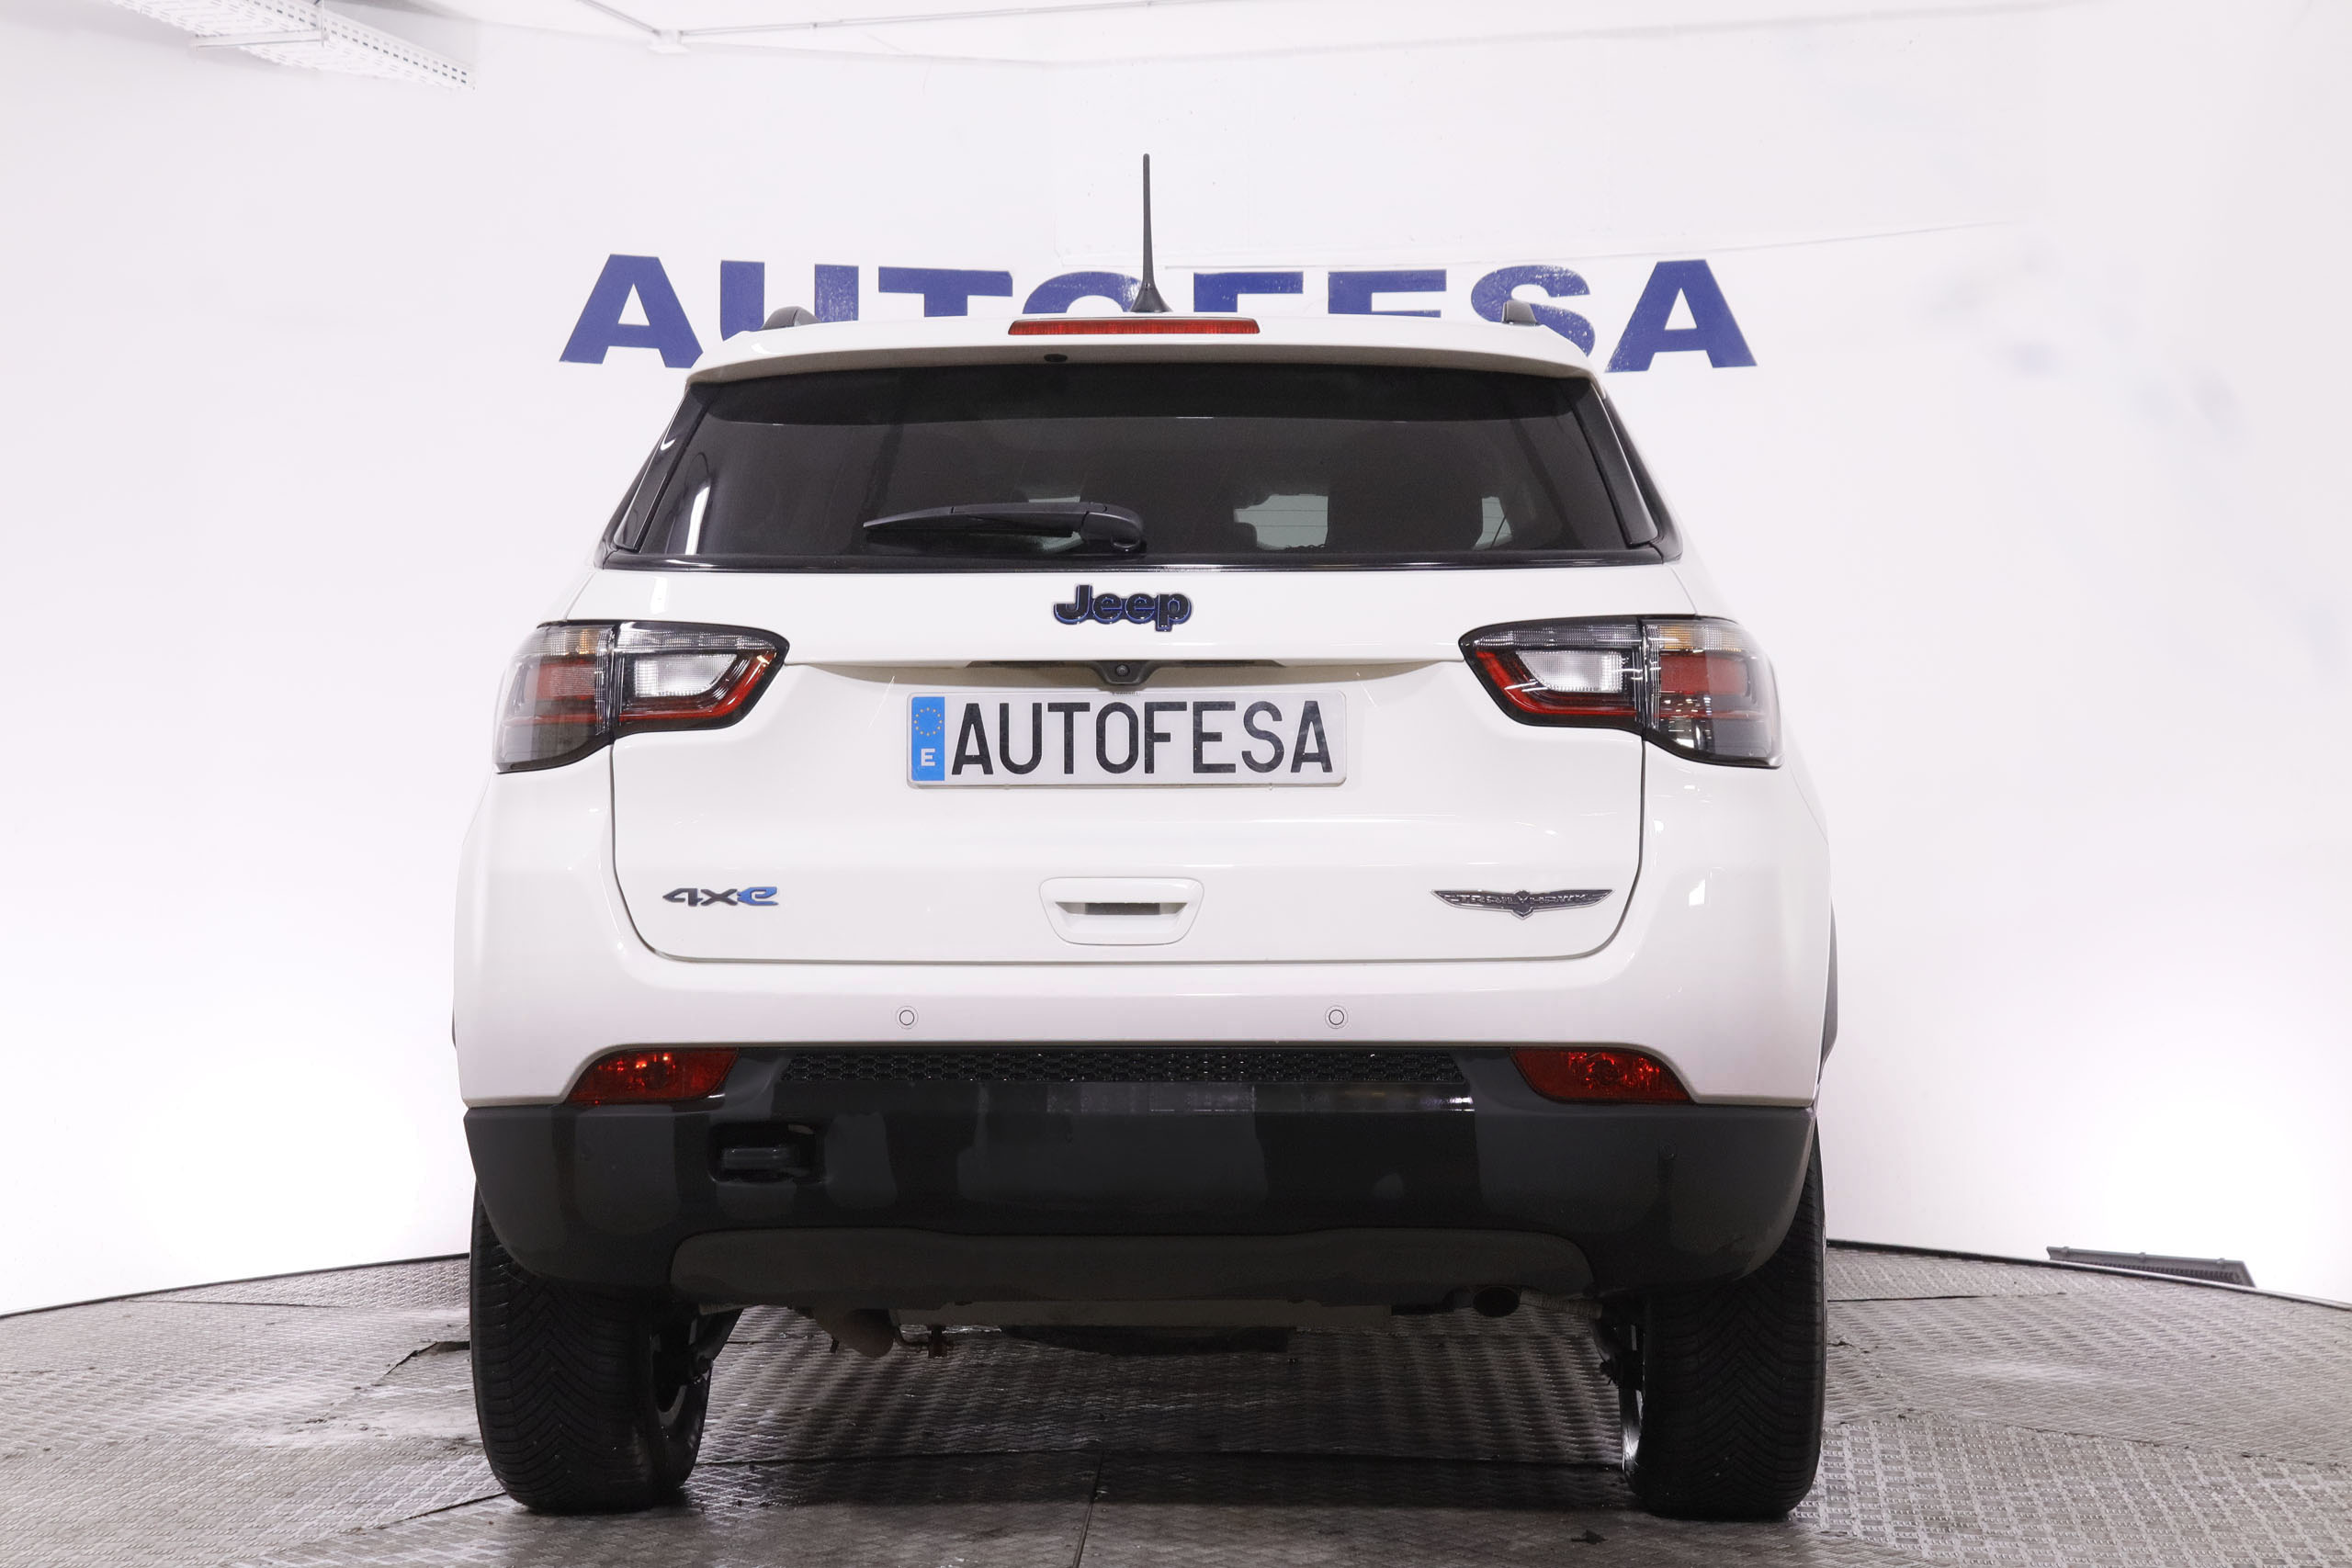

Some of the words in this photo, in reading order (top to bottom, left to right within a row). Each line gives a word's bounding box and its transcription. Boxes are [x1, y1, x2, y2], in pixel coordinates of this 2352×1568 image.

[1054, 584, 1193, 632] Jeep
[921, 748, 936, 767] E
[951, 700, 1333, 775] AUTOFESA
